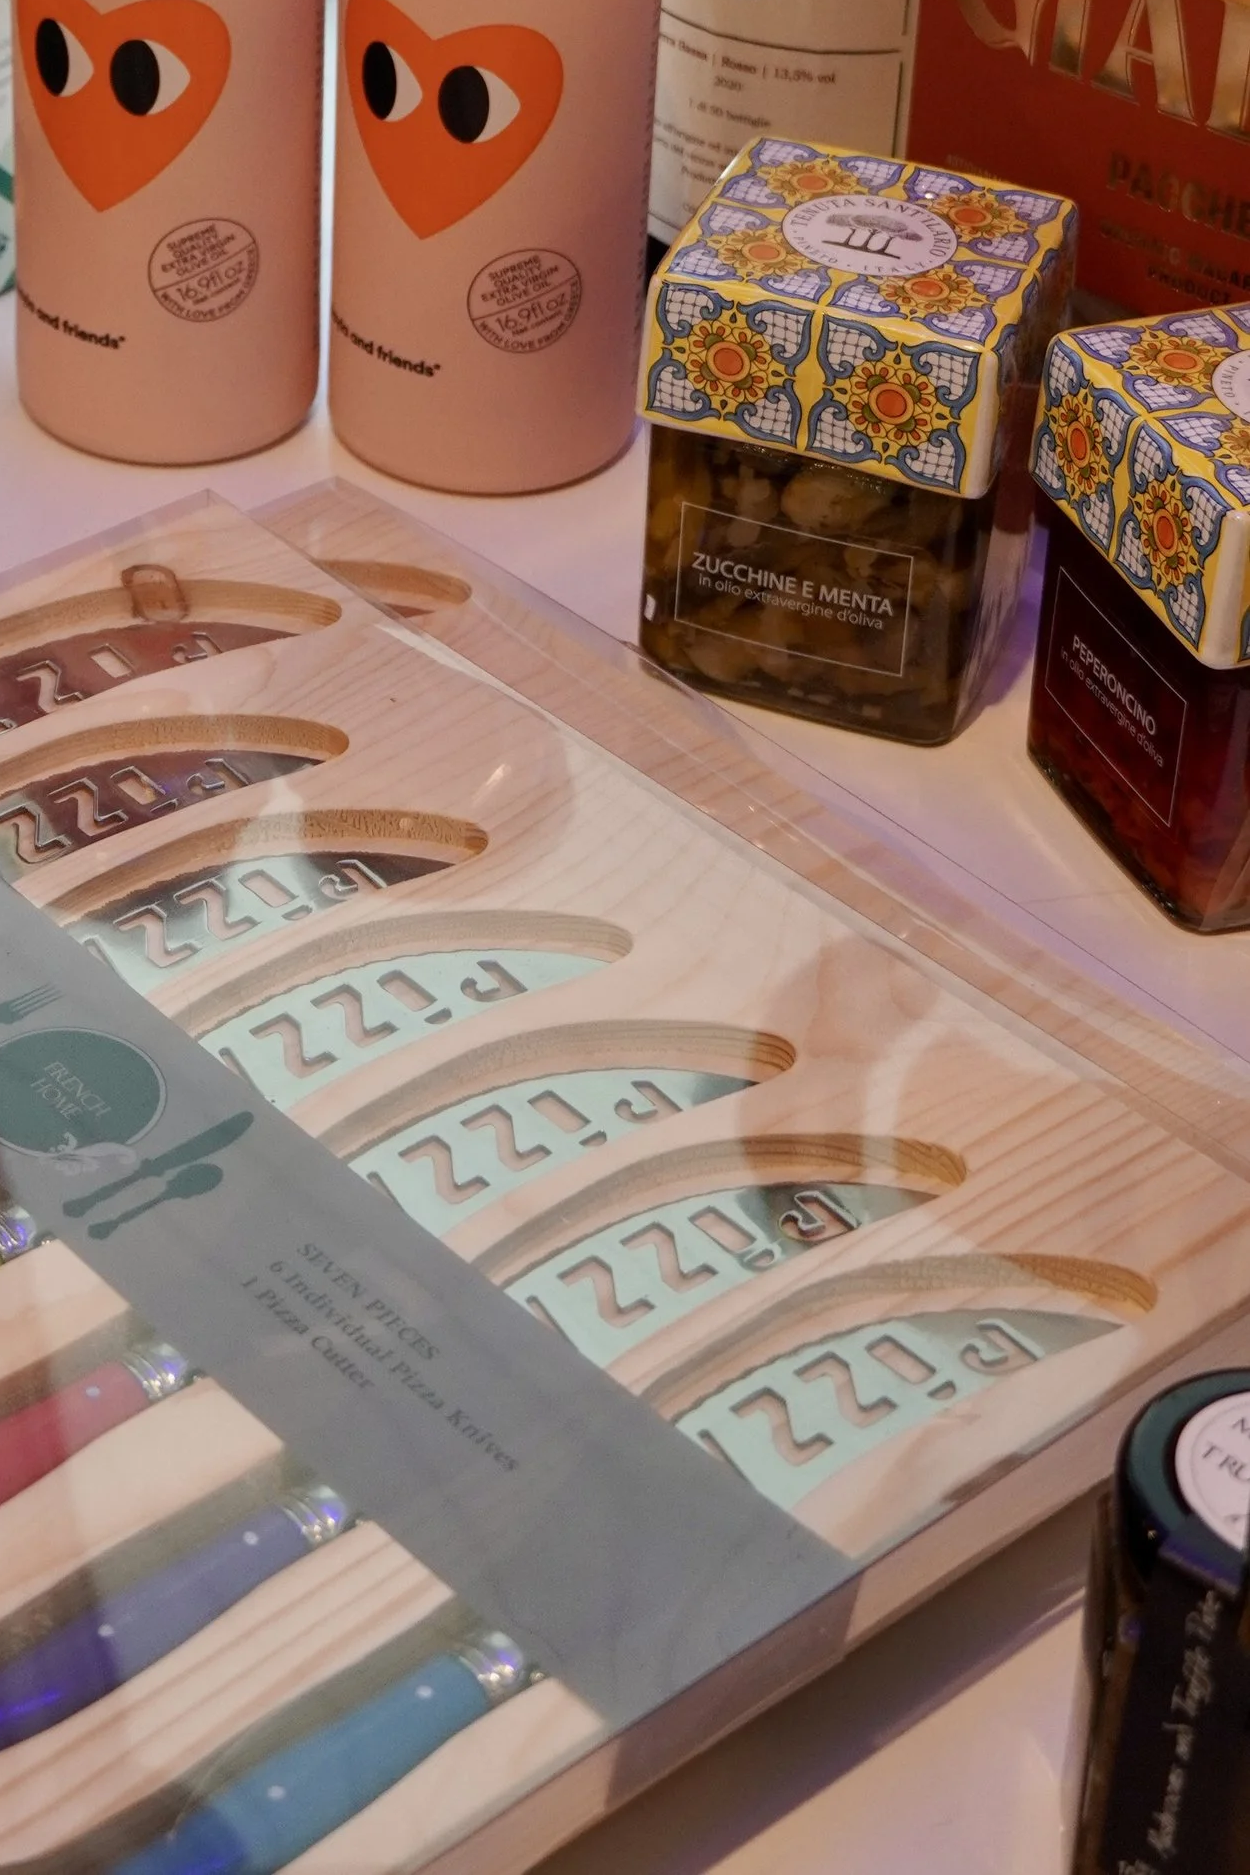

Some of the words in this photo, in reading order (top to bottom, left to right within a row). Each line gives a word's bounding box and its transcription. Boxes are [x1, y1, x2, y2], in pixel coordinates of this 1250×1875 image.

[789, 197, 857, 228] TENUTA
[864, 197, 952, 258] SANT'ILARIO
[793, 235, 838, 265] PINETO
[862, 260, 926, 274] ITALY
[488, 255, 542, 282] SUPREME
[349, 332, 375, 356] and
[376, 344, 436, 379] friends
[690, 551, 798, 595] ZUCCHINE
[801, 580, 815, 599] E
[818, 584, 895, 618] MENTA
[698, 575, 712, 589] in
[714, 577, 742, 597] olio
[743, 588, 835, 620] extravergine
[836, 608, 885, 631] d'oliva
[1060, 645, 1070, 663] in
[1068, 658, 1085, 682] olio
[1085, 676, 1138, 739] extravergine
[1136, 731, 1165, 769] d'oliva
[1071, 633, 1157, 737] PEPERONCINO
[30, 1077, 84, 1120] HOME
[43, 1060, 112, 1118] FRENCH
[296, 1241, 368, 1300] SEVEN
[364, 1297, 442, 1361] PIECES
[254, 1287, 311, 1336] Pizza
[310, 1334, 376, 1390] Cutter
[268, 1259, 287, 1274] 6
[283, 1271, 395, 1364] Individual
[389, 1359, 446, 1411] Pizza
[445, 1408, 520, 1473] Knives
